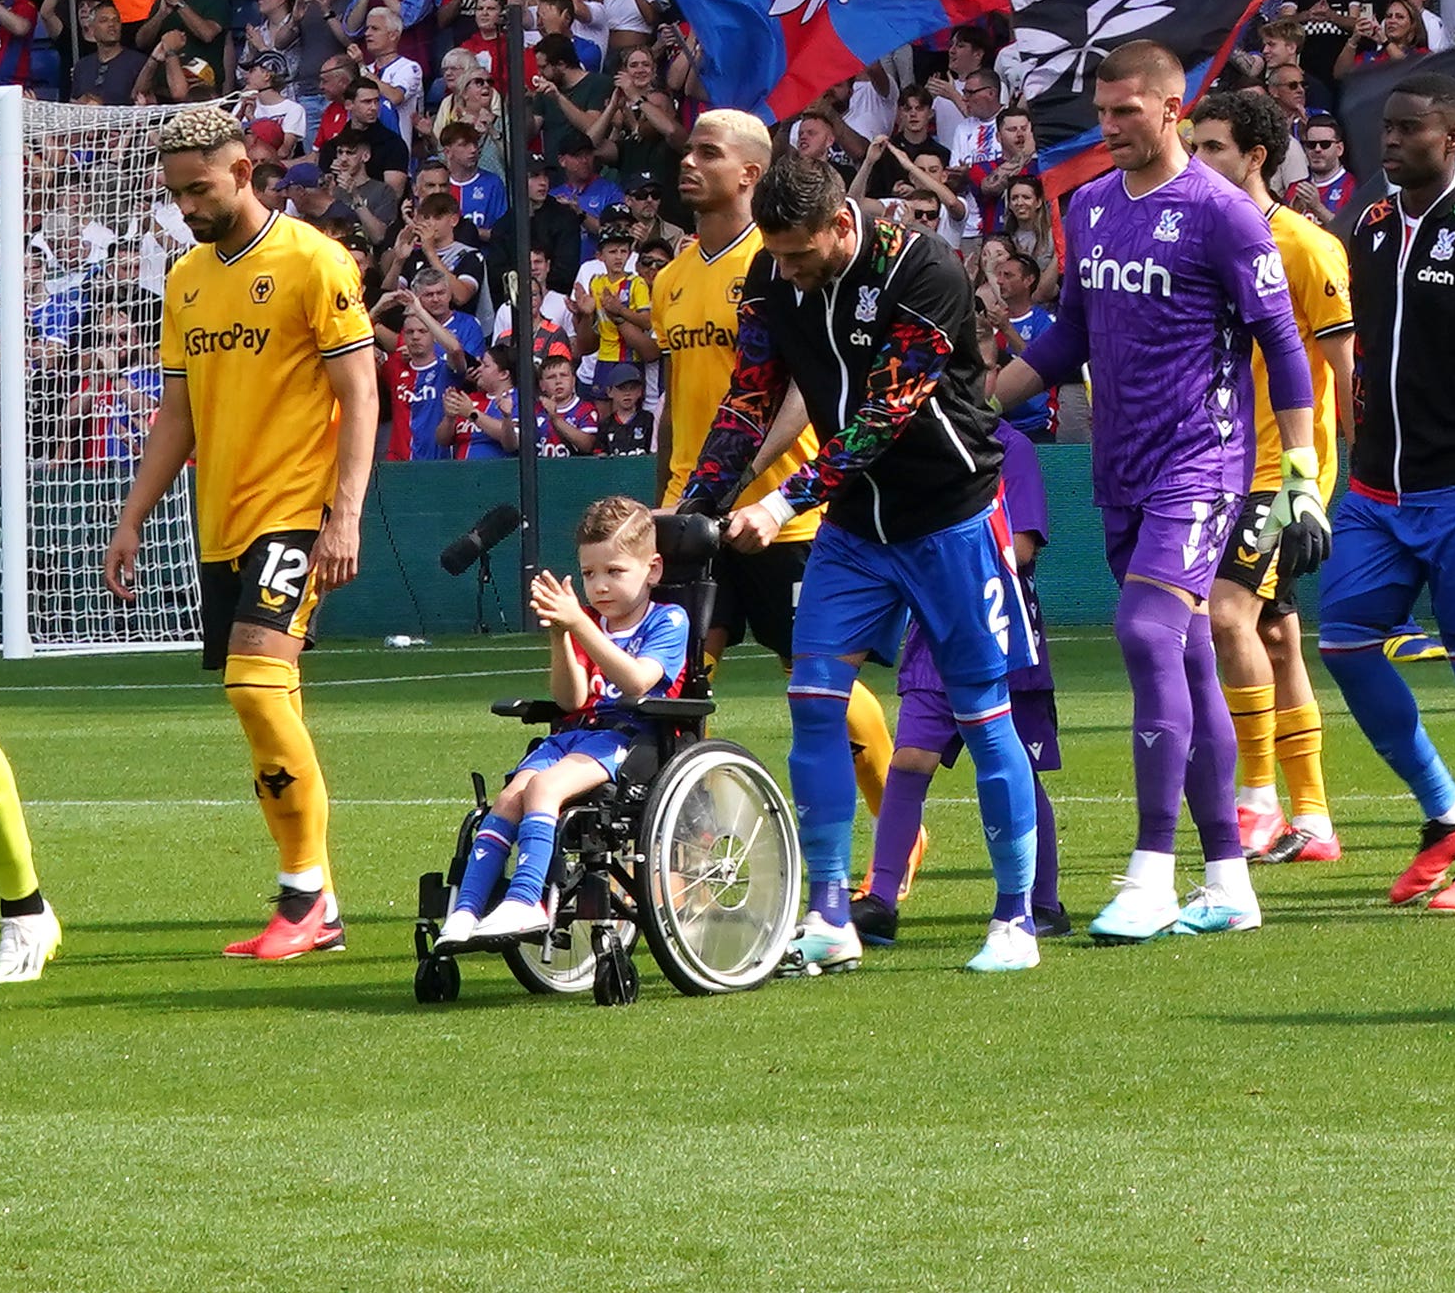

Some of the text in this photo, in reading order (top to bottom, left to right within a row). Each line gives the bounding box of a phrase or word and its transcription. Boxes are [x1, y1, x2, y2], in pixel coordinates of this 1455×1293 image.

[1079, 245, 1172, 297] cinch
[1417, 266, 1454, 286] cinch
[184, 322, 270, 356] AstroPay
[849, 328, 873, 346] cin
[259, 541, 308, 591] 12
[984, 577, 1010, 630] 2
